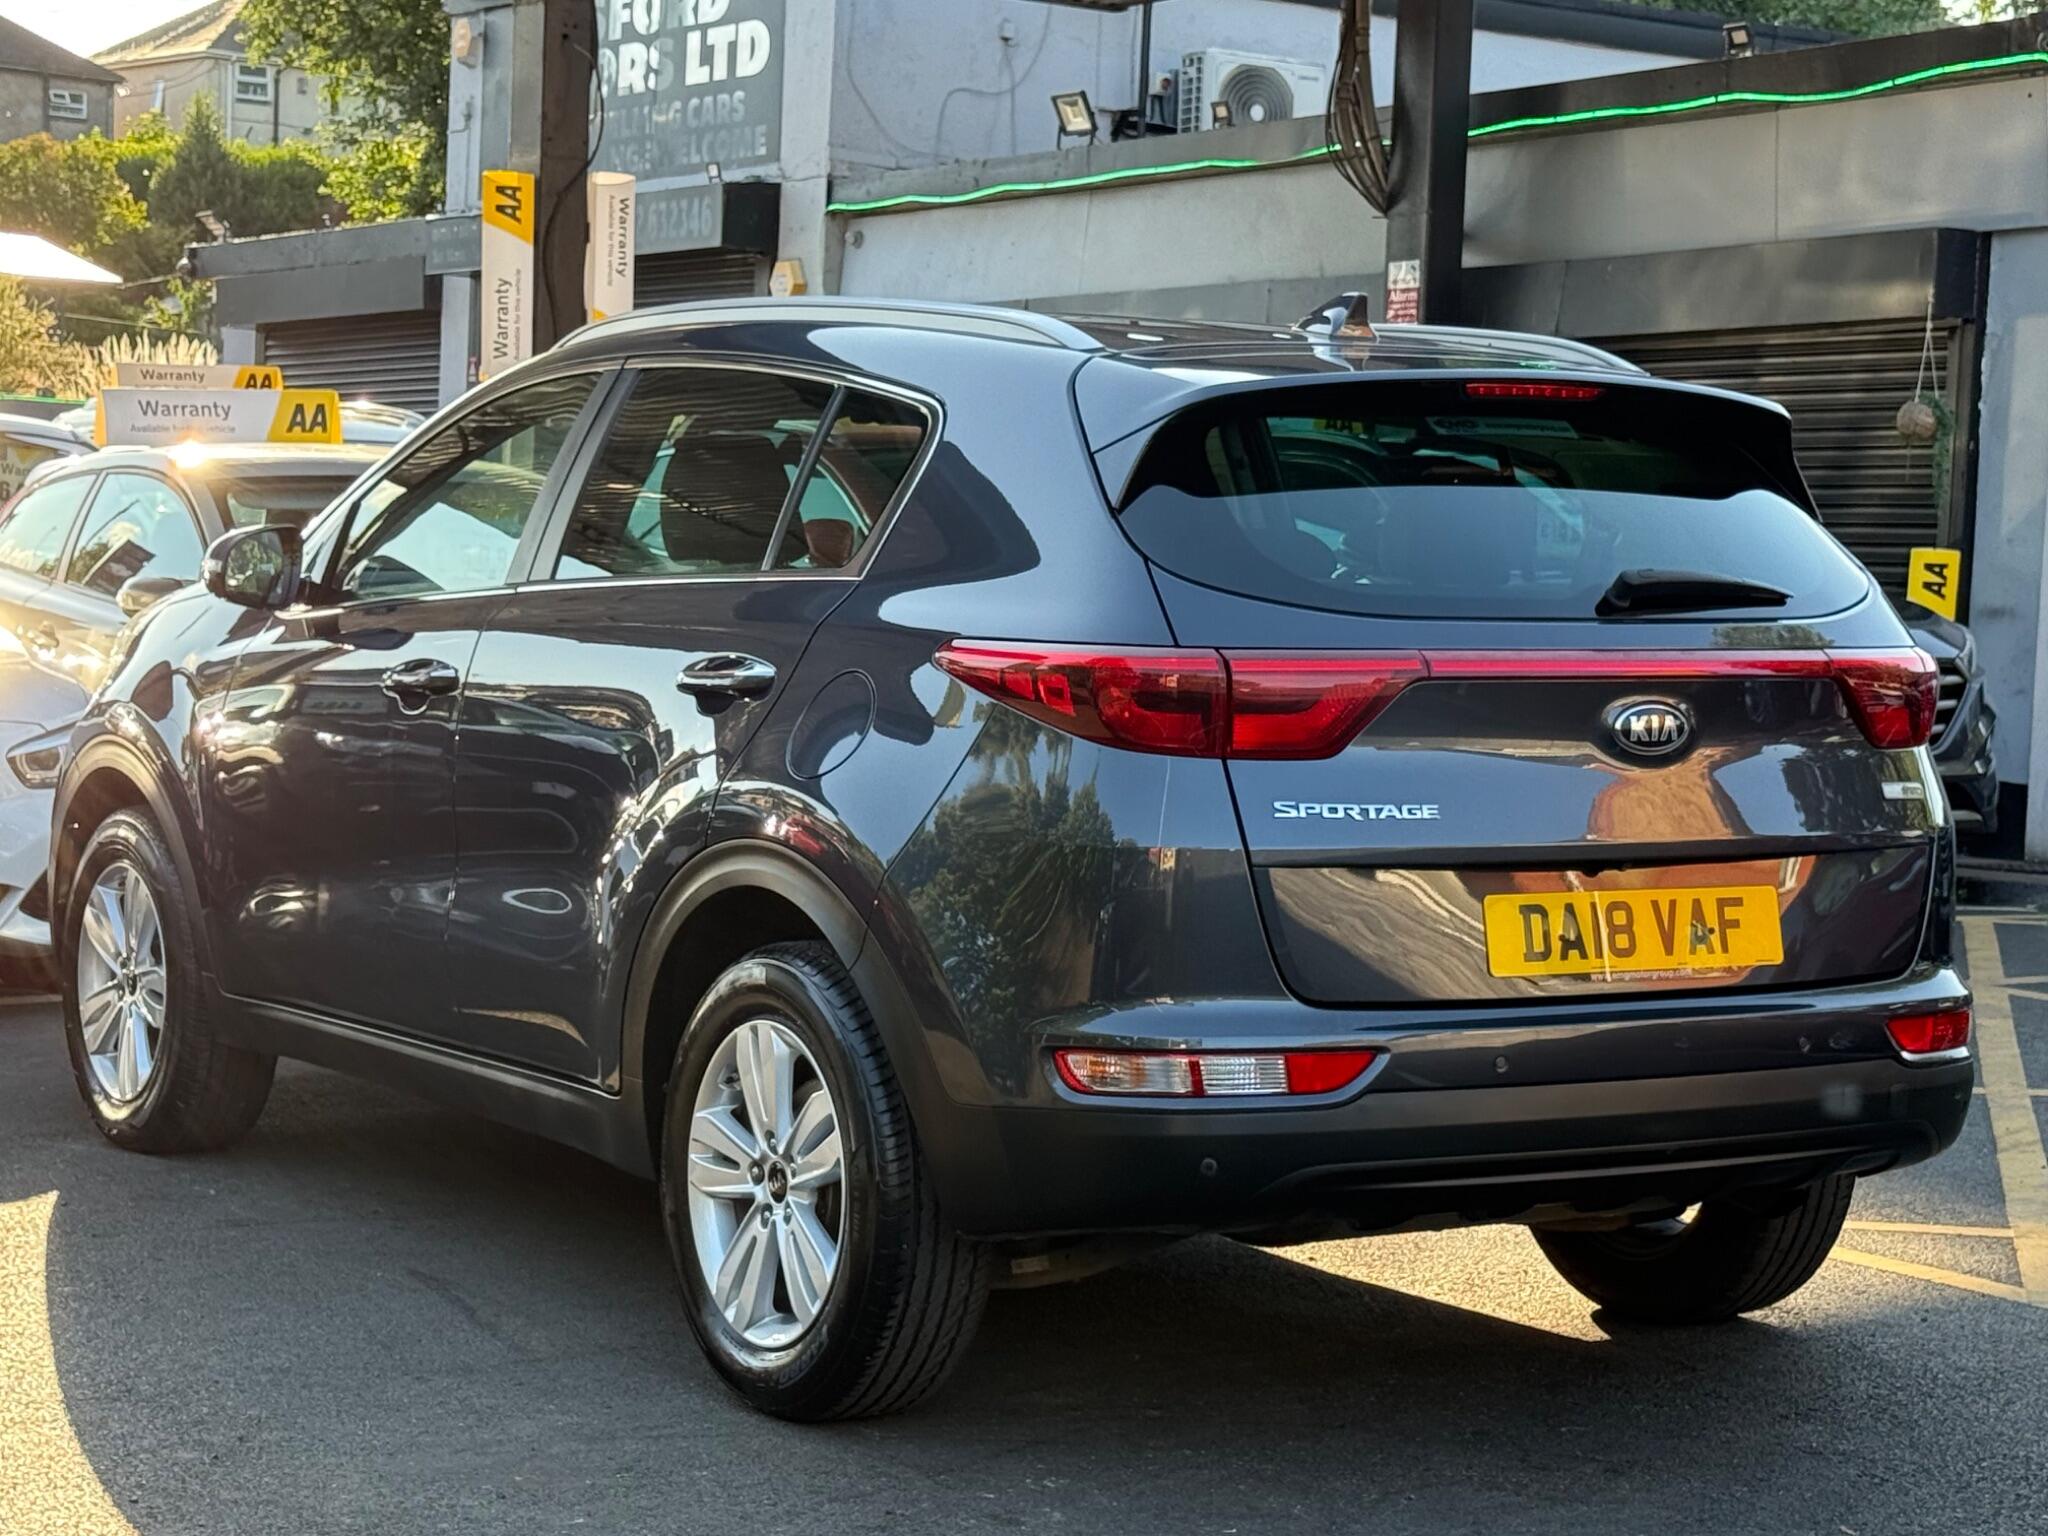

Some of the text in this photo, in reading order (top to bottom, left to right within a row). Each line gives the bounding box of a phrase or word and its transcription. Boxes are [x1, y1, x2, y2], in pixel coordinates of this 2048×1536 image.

[685, 19, 771, 86] LTD
[686, 90, 746, 129] CARS
[495, 185, 522, 224] AA
[615, 197, 630, 278] Warranty
[493, 278, 512, 359] Warranty
[140, 368, 272, 389] Warranty AA
[130, 423, 171, 434] Available
[137, 400, 328, 433] Warranty AA
[1922, 563, 1949, 601] AA
[1628, 714, 1678, 743] KIA
[1273, 801, 1440, 821] SPORTAGE
[1518, 896, 1744, 962] DA18 VAF
